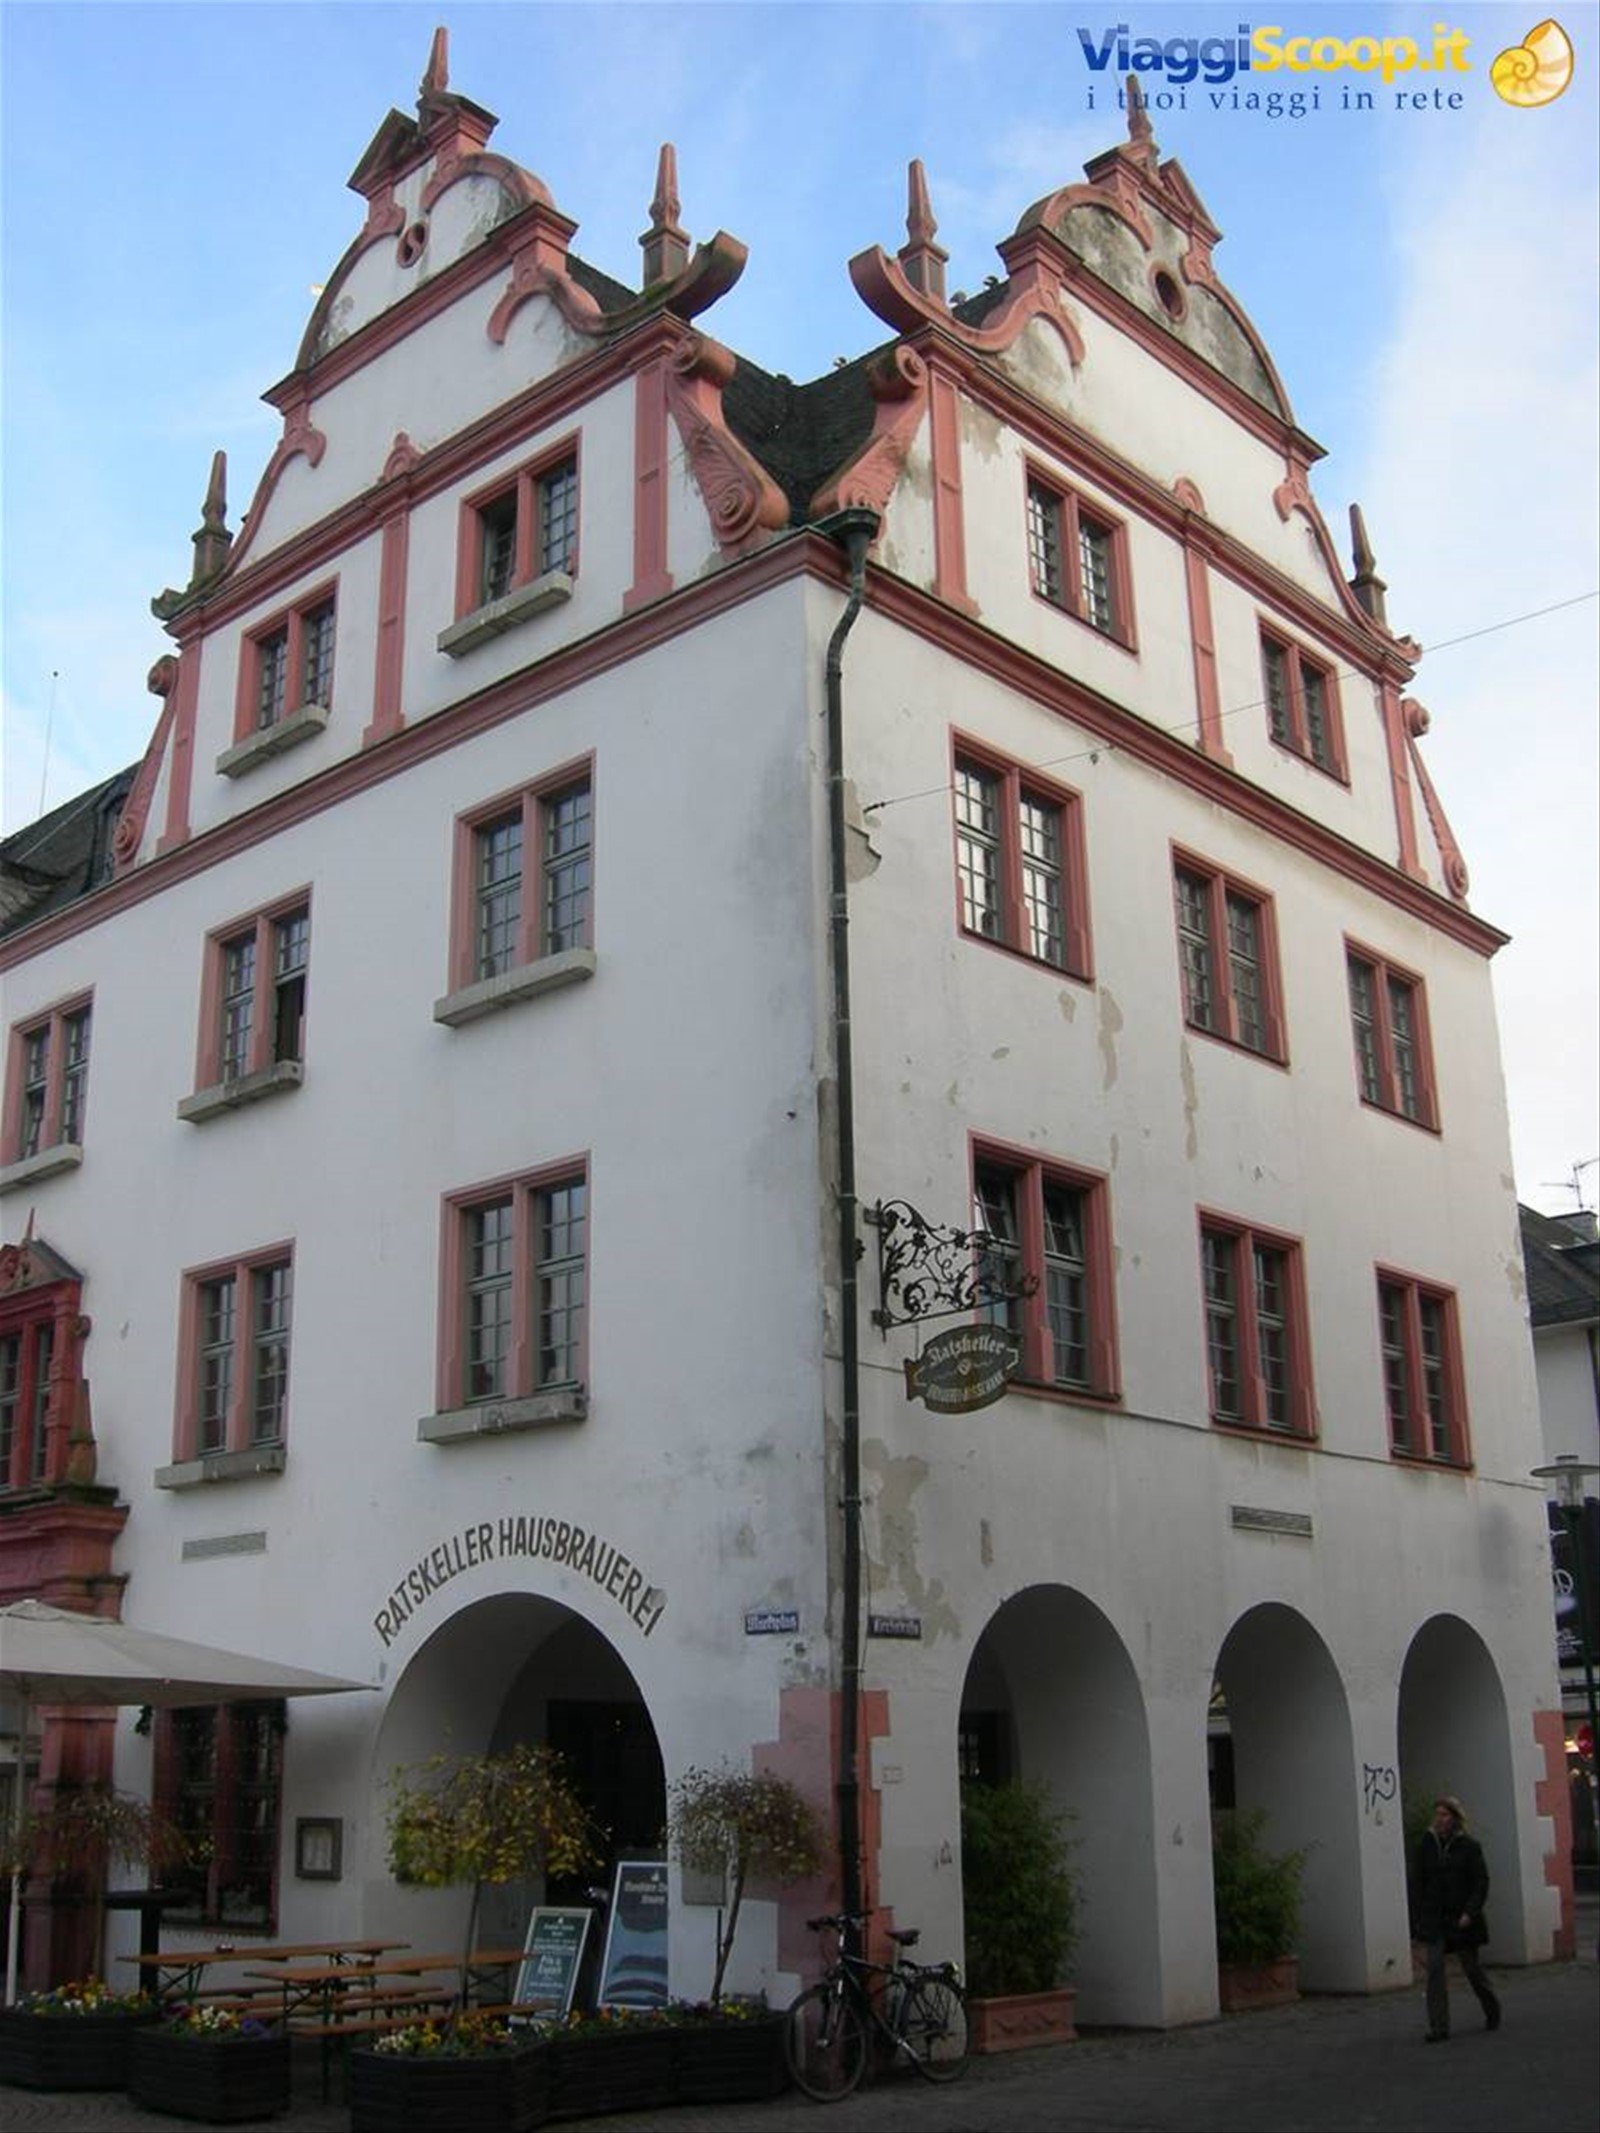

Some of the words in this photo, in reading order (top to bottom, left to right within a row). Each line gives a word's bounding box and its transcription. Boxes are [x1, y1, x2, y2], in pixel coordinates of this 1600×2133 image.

[929, 1334, 1005, 1366] Ratskeller
[374, 1522, 493, 1647] RATSKELLER
[499, 1517, 665, 1636] HAUSBRAUEREI
